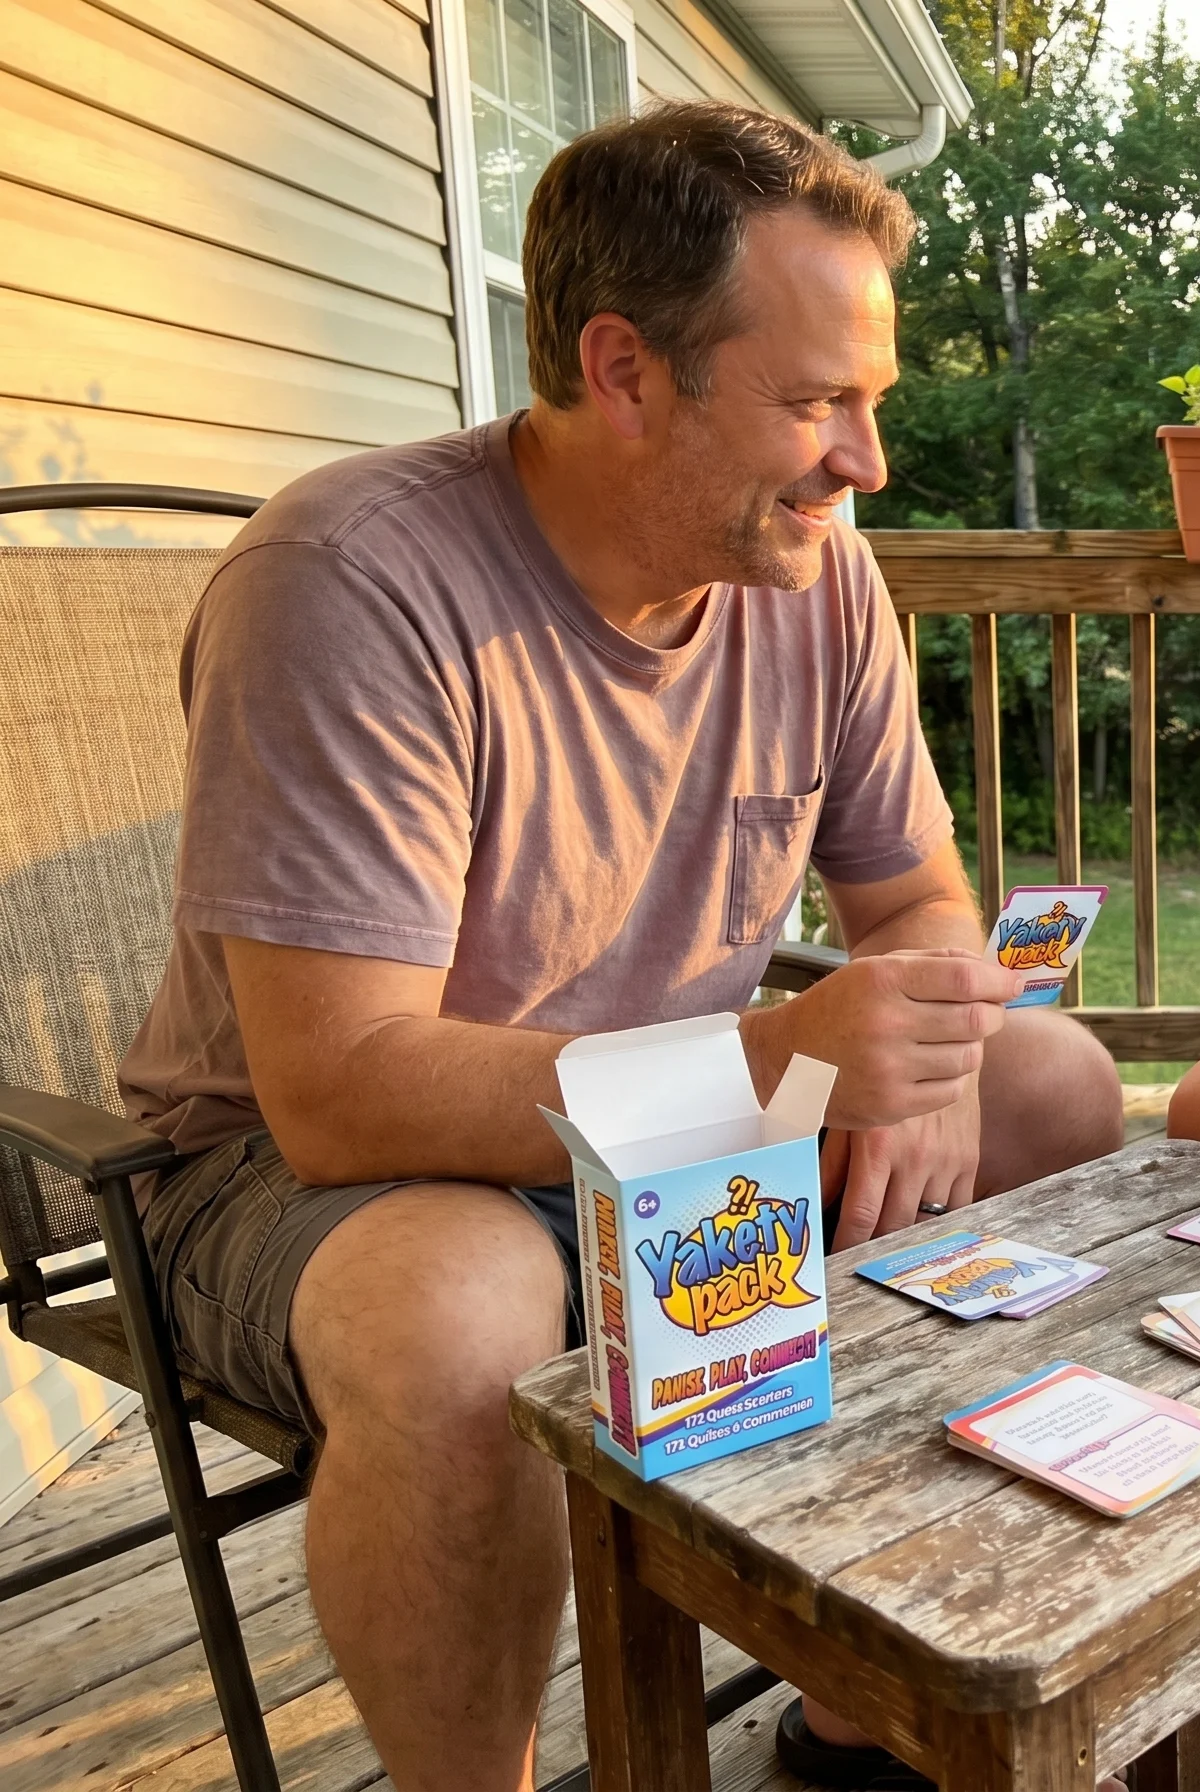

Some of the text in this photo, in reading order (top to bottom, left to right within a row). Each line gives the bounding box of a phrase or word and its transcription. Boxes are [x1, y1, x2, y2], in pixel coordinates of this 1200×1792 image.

[638, 1199, 657, 1213] 6+
[635, 1198, 809, 1298] Yakety
[690, 1252, 786, 1336] pack
[709, 1353, 748, 1391] PLAY,
[684, 1412, 706, 1429] 172
